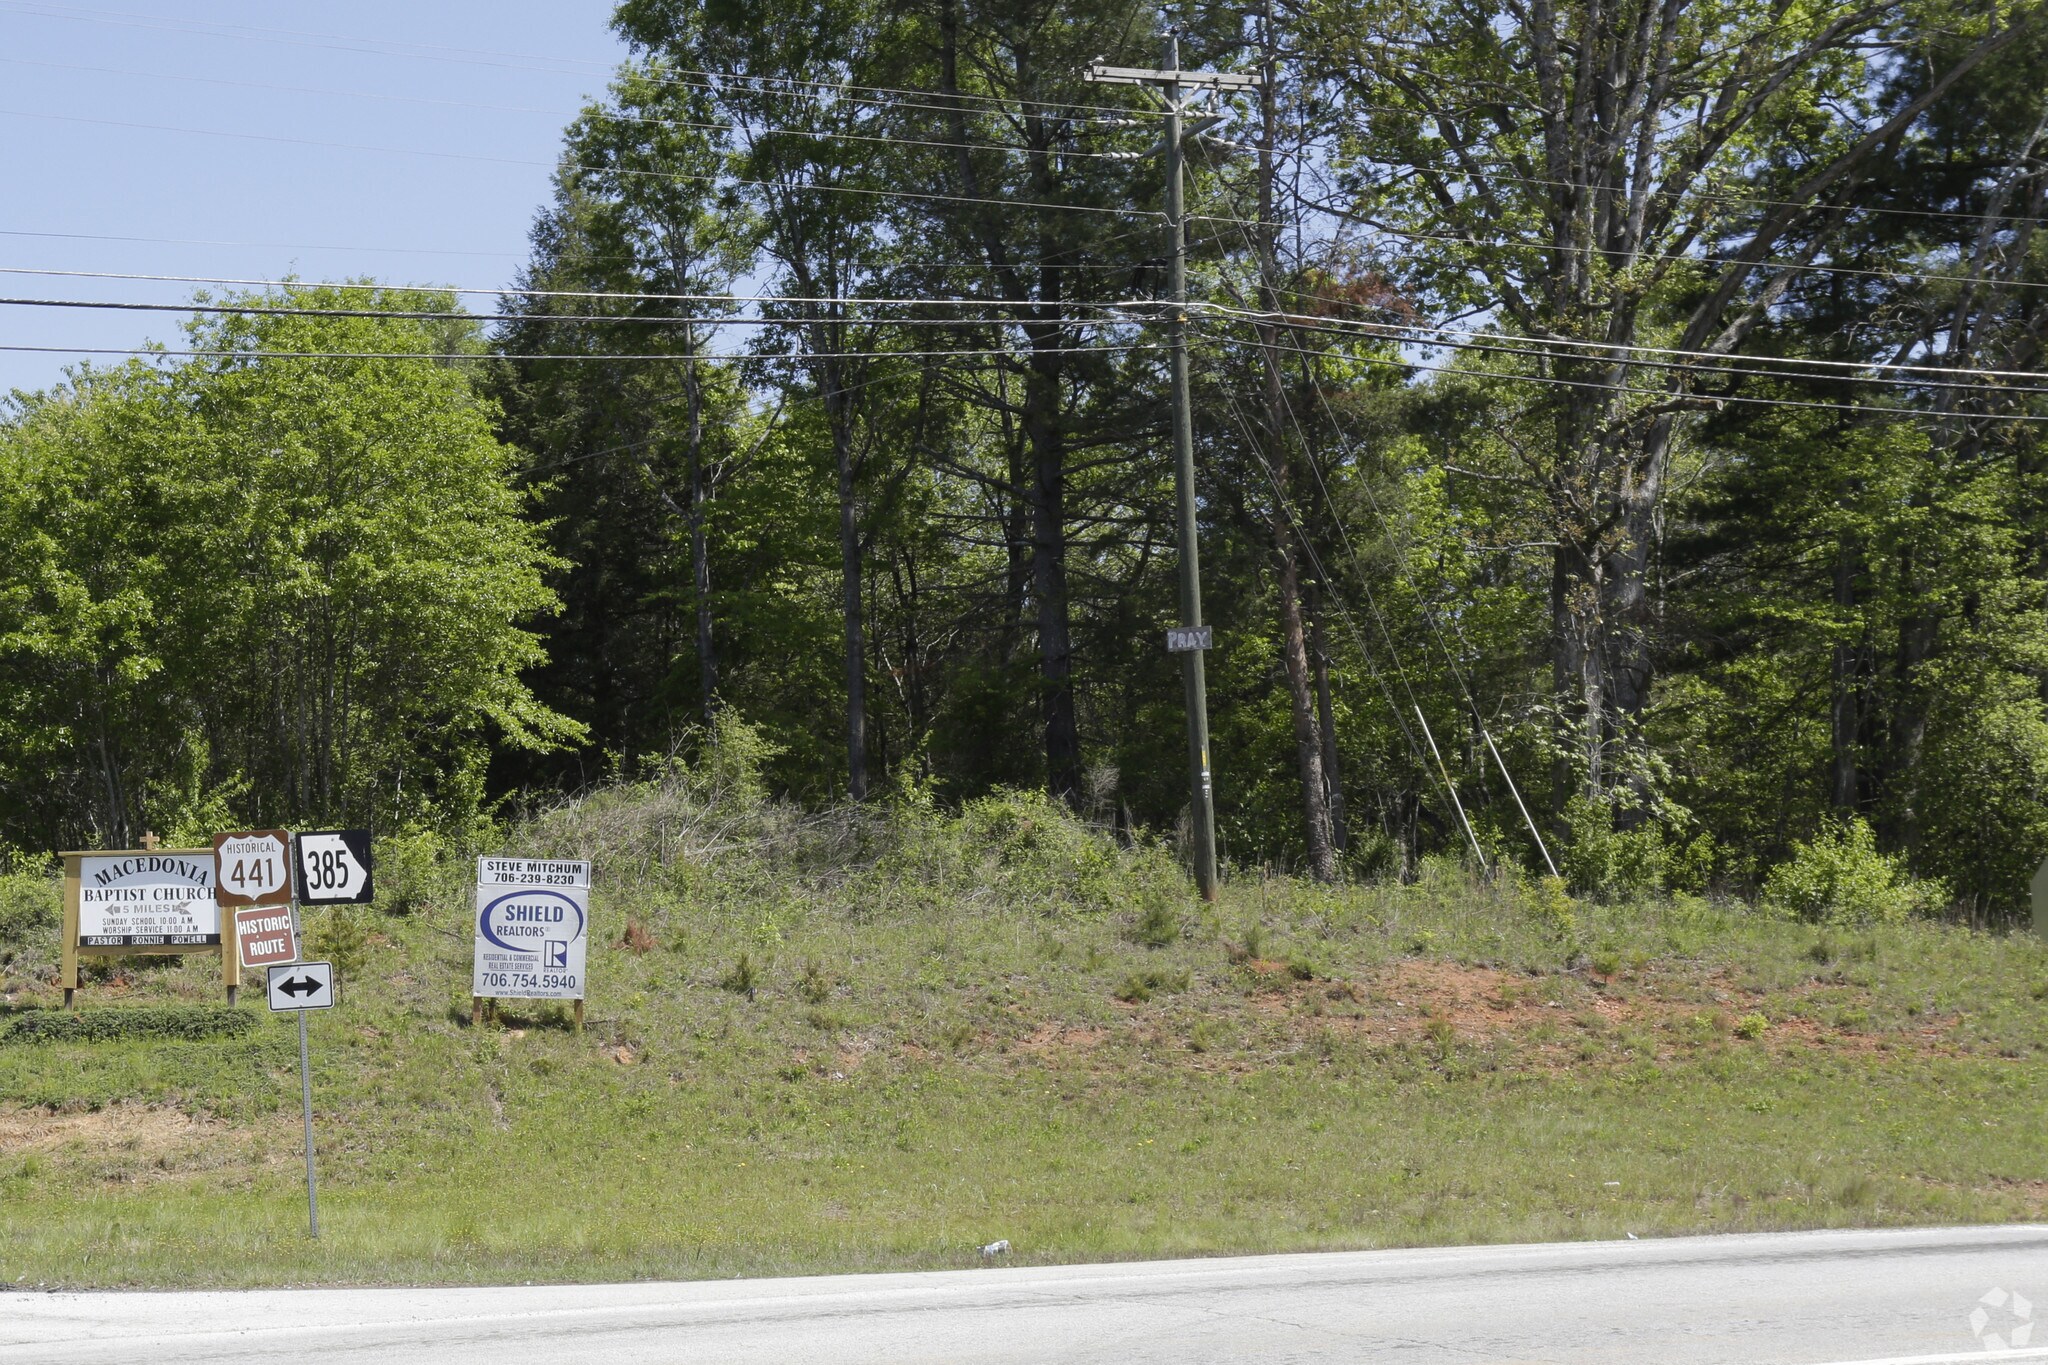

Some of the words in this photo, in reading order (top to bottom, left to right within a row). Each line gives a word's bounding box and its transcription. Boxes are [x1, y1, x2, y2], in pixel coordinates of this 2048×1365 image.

[1167, 631, 1207, 648] PRAY
[226, 842, 276, 854] HISTORICAL
[93, 857, 208, 887] MACEDONIA
[231, 858, 274, 888] 441
[307, 850, 349, 890] 385
[487, 861, 522, 871] STEVE
[527, 862, 582, 874] MITCHUM
[494, 873, 574, 885] 706-239-8230
[84, 888, 147, 902] BAPTIST
[153, 887, 216, 901] CHURCH
[123, 905, 129, 913] 5
[133, 904, 170, 913] MILES
[505, 904, 564, 922] SHIELD
[102, 917, 128, 926] SUNDAY
[131, 917, 156, 925] SCHOOL
[238, 915, 290, 935] HISTORIC
[102, 926, 132, 934] WORSHIP
[135, 925, 163, 934] SERVICE
[88, 936, 122, 945] PASTOR
[132, 936, 164, 944] RONNIE
[171, 935, 206, 944] POWELL
[249, 938, 286, 957] ROUTE
[482, 973, 576, 988] 706.754.5940
